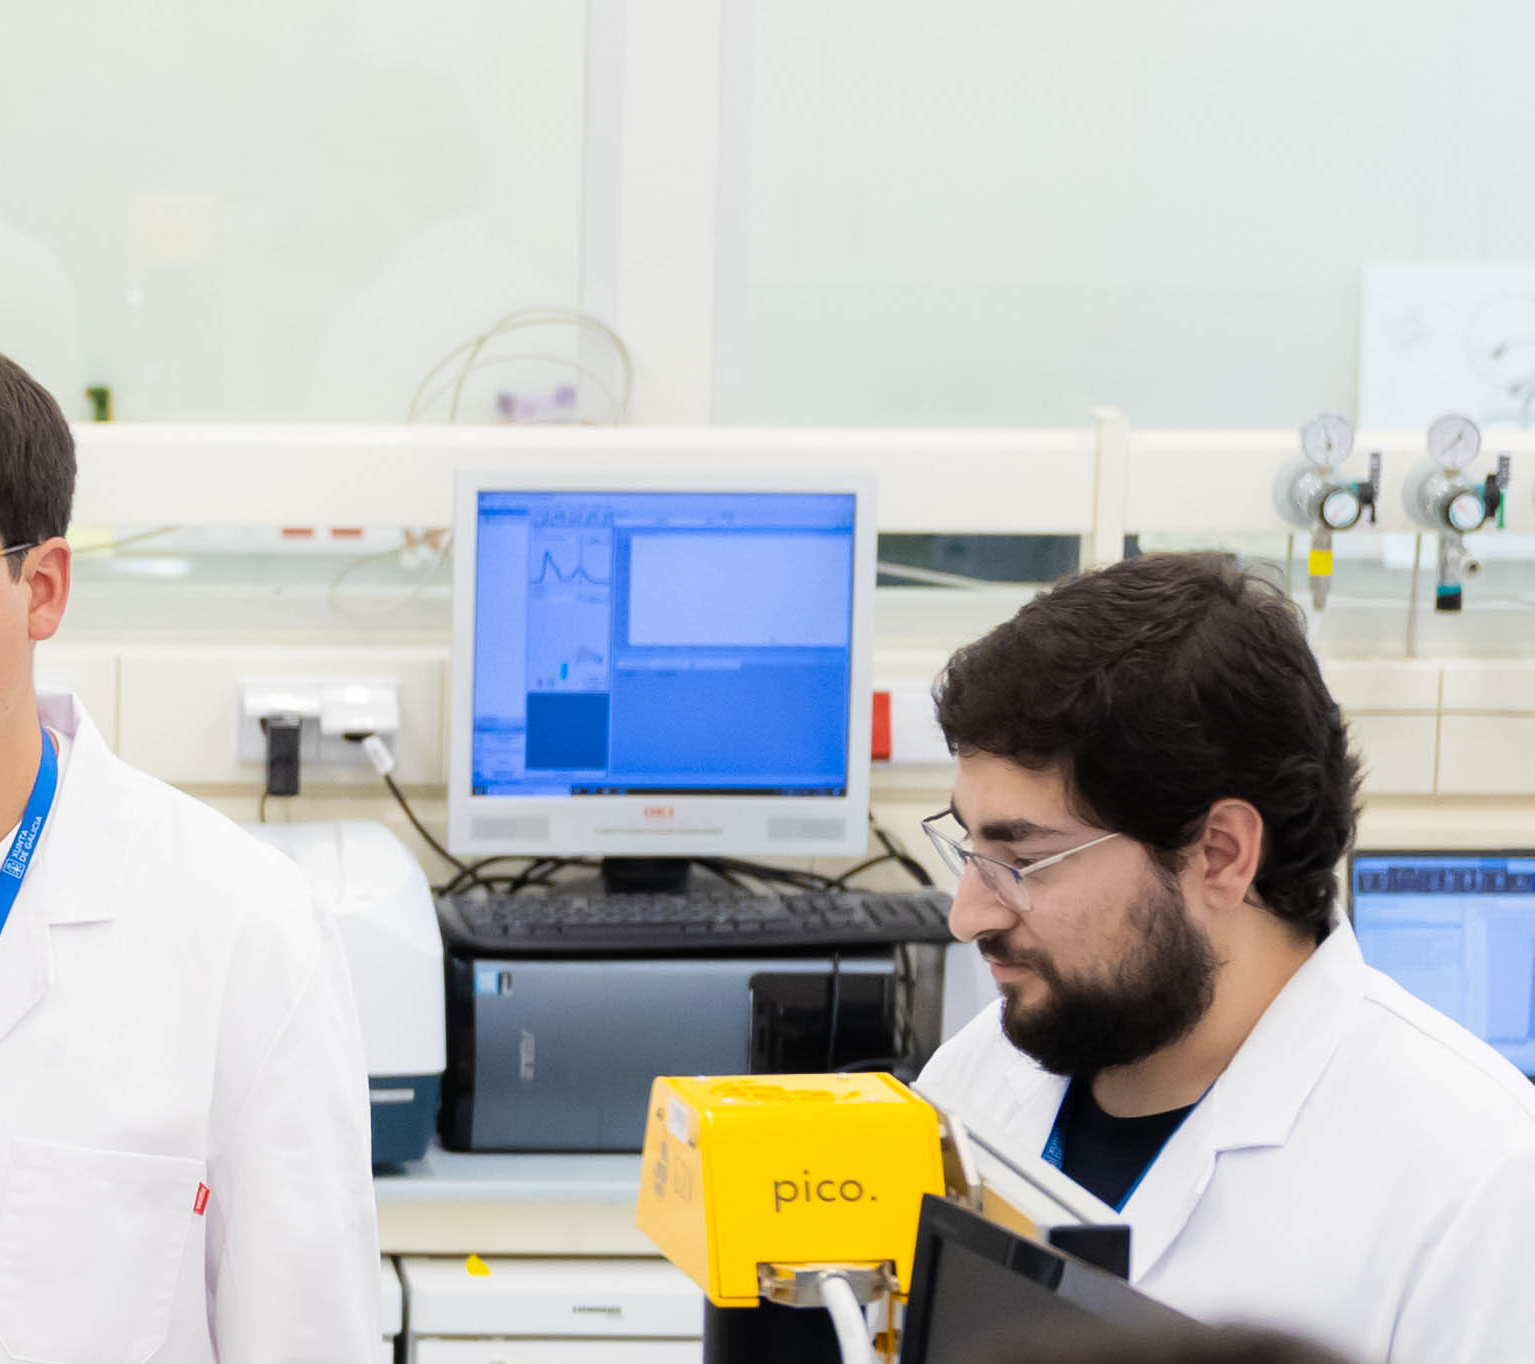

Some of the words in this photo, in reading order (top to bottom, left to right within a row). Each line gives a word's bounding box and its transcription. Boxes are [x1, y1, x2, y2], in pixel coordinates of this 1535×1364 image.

[11, 829, 29, 858] XUNTA
[18, 850, 30, 863] DE
[25, 816, 43, 850] GALICIA
[772, 1169, 878, 1213] pico.
